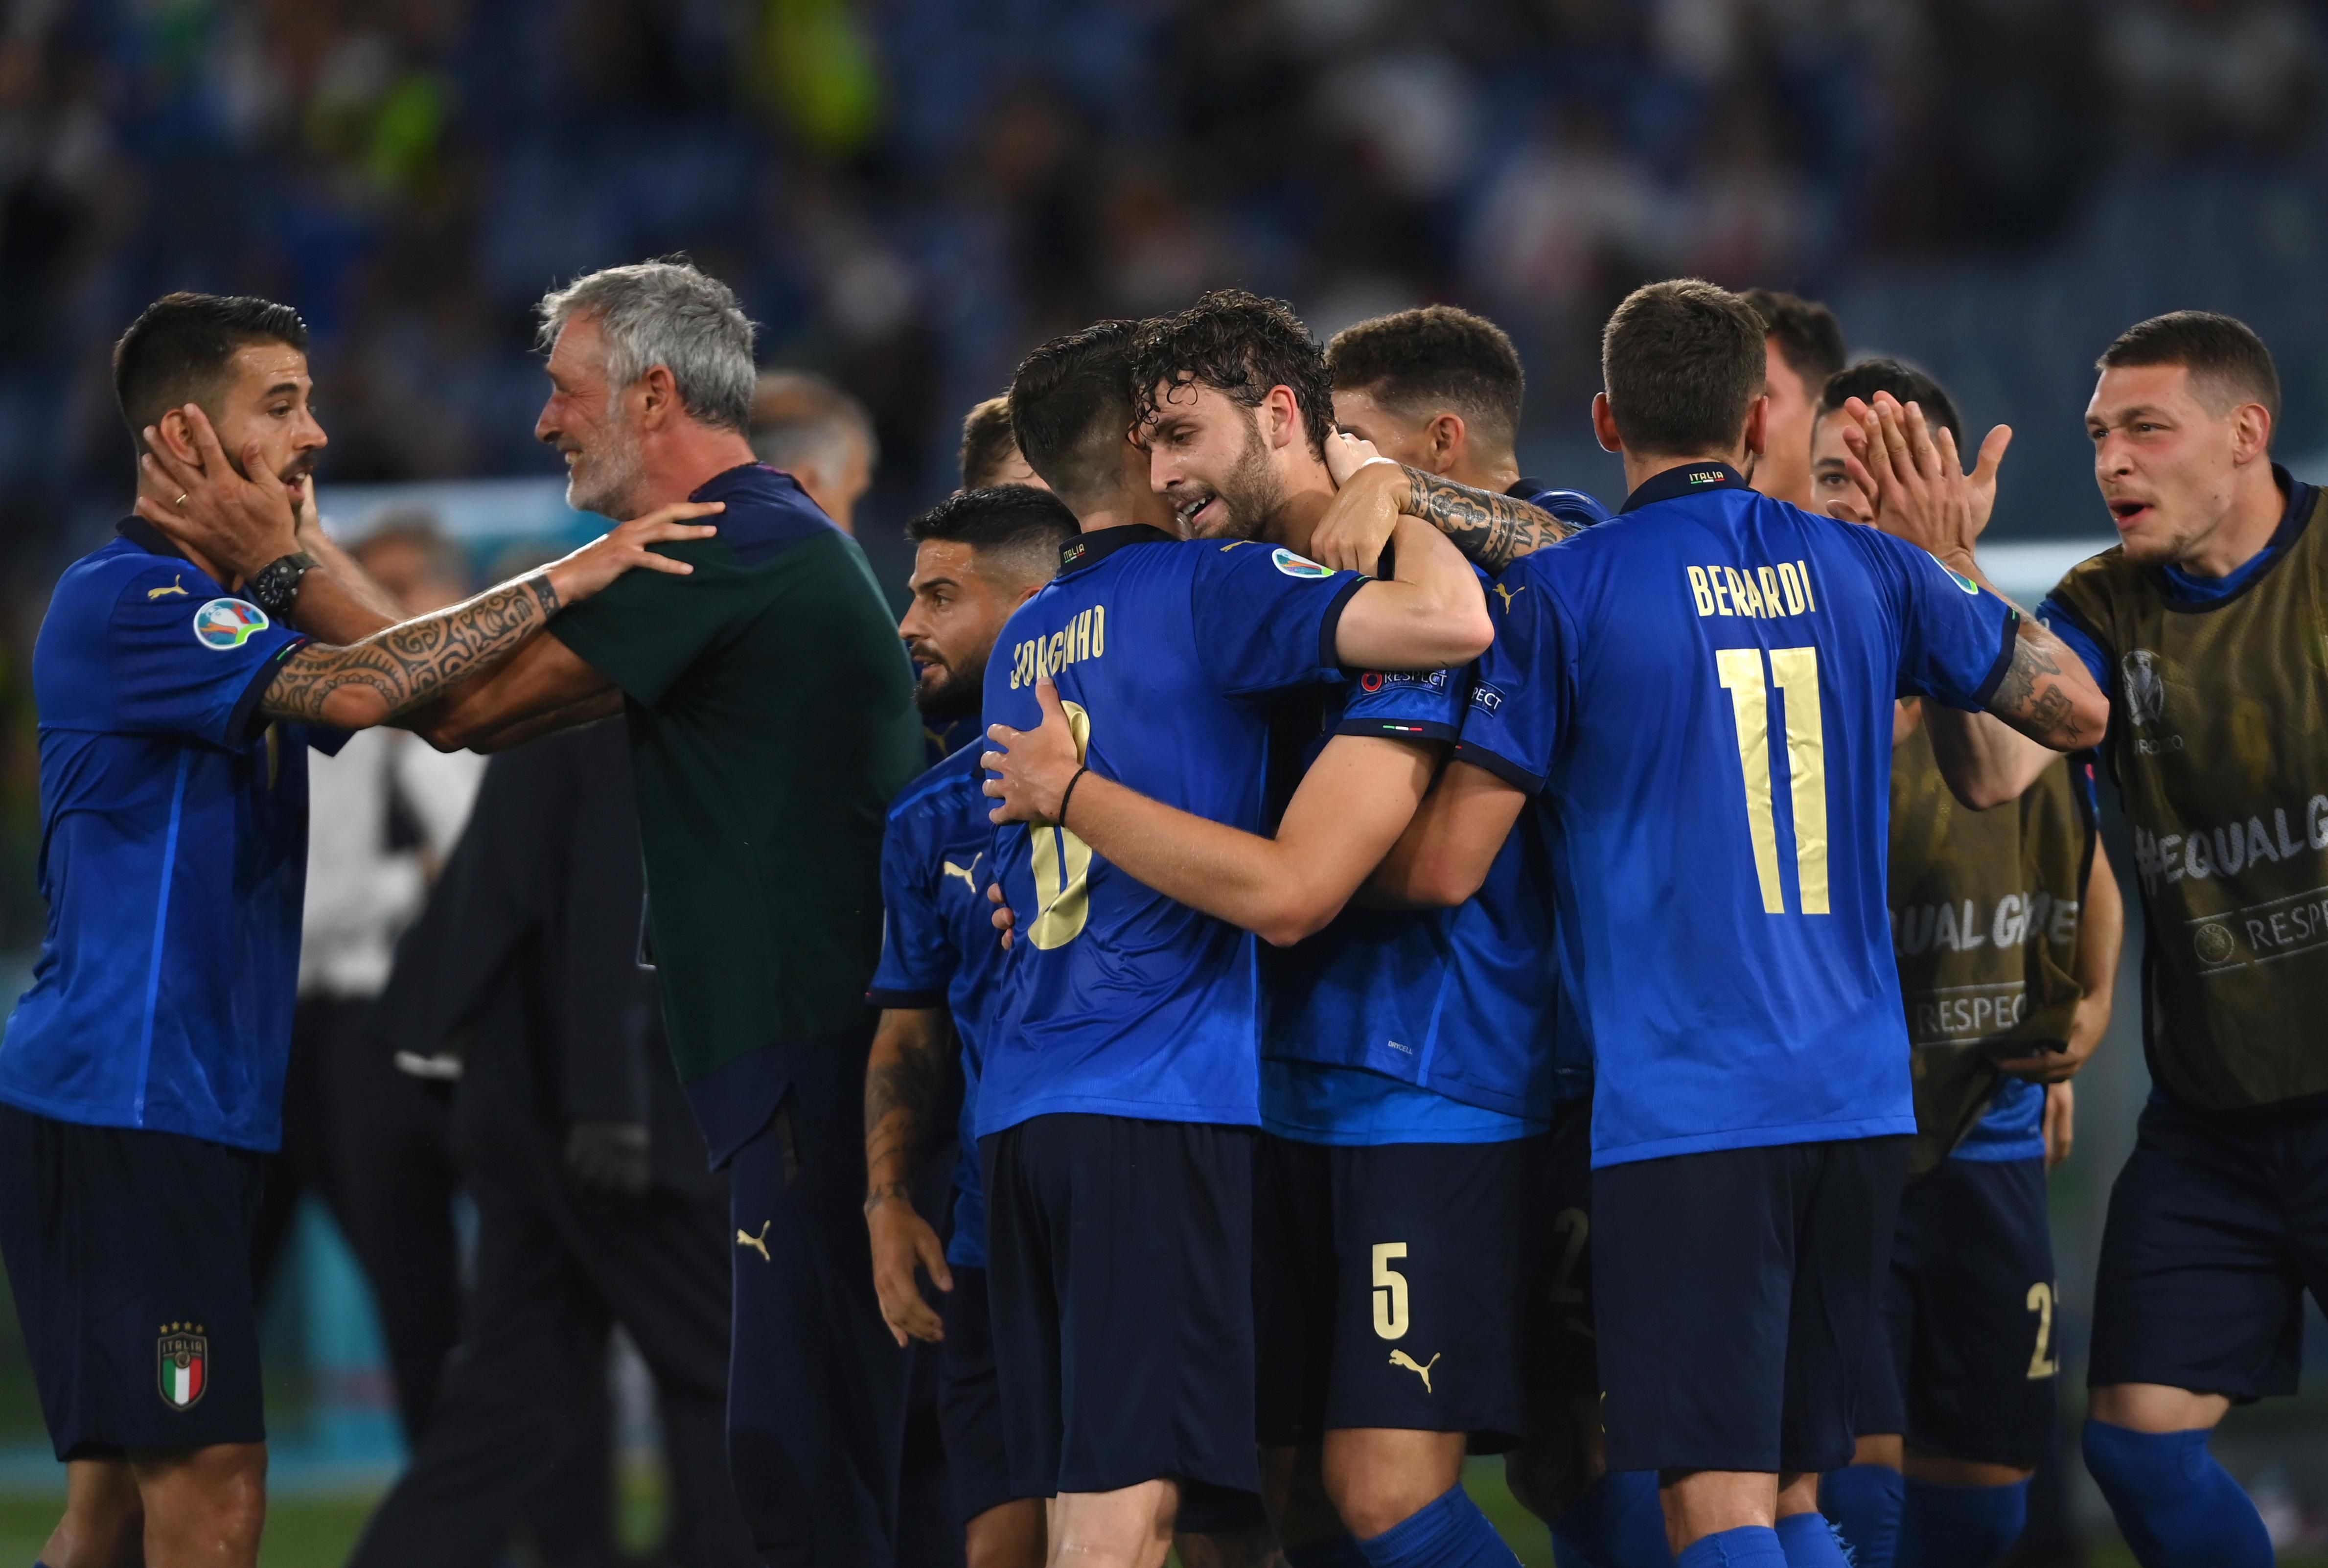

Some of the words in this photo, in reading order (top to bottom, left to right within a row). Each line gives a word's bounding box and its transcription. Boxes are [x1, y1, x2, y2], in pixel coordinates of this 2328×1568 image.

[1689, 471, 1724, 481] ITALIA
[1063, 543, 1085, 560] ITALIA
[1687, 560, 1816, 619] BERARDI
[1715, 646, 1830, 914] 11
[1388, 1040, 1413, 1055] DRYCELL
[1372, 1242, 1409, 1340] 5
[162, 1340, 202, 1353] ITALIA
[2027, 1281, 2059, 1378] 2
